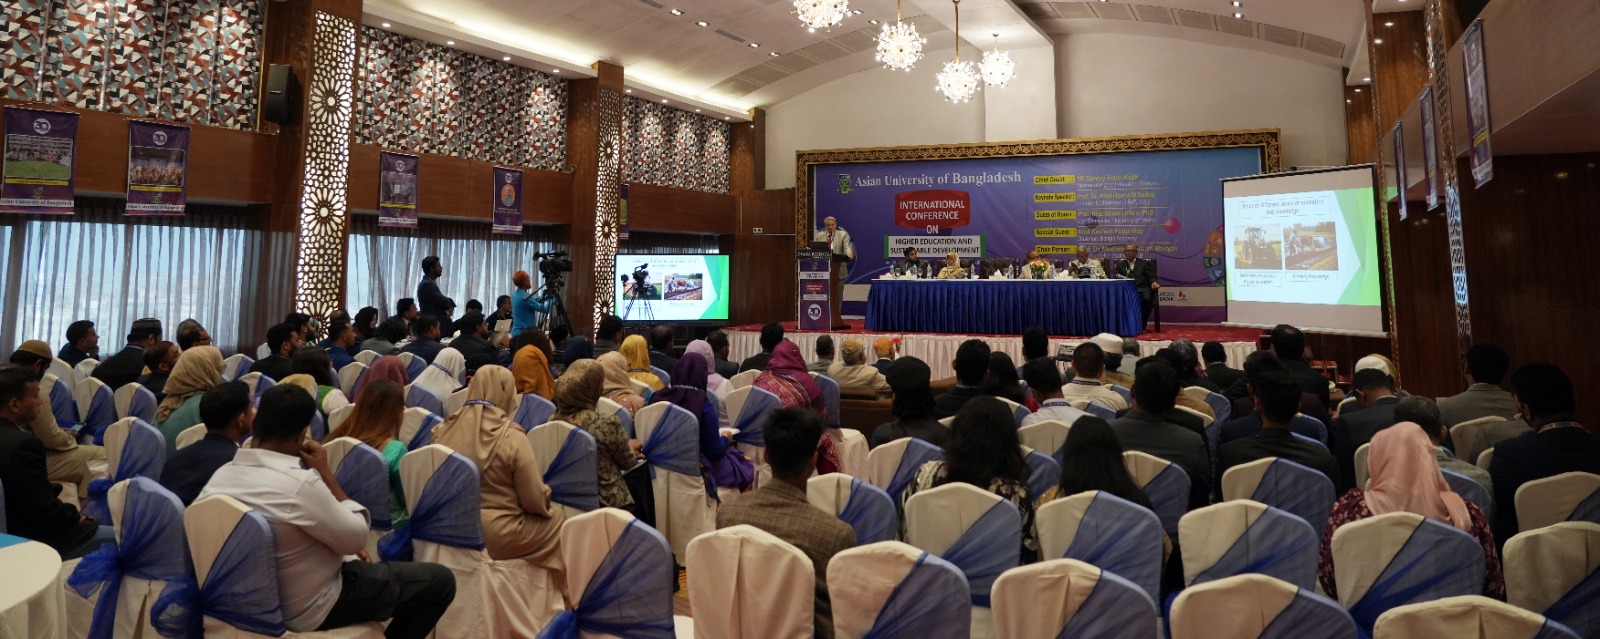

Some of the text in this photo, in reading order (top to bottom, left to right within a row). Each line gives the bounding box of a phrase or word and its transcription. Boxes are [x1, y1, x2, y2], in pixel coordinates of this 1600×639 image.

[855, 171, 1021, 188] Asian University of Bangladesh
[900, 200, 965, 209] INTERNATIONAL
[905, 211, 959, 220] CONFERENCE
[926, 225, 939, 234] ON
[932, 246, 980, 254] DEVELOPMENT
